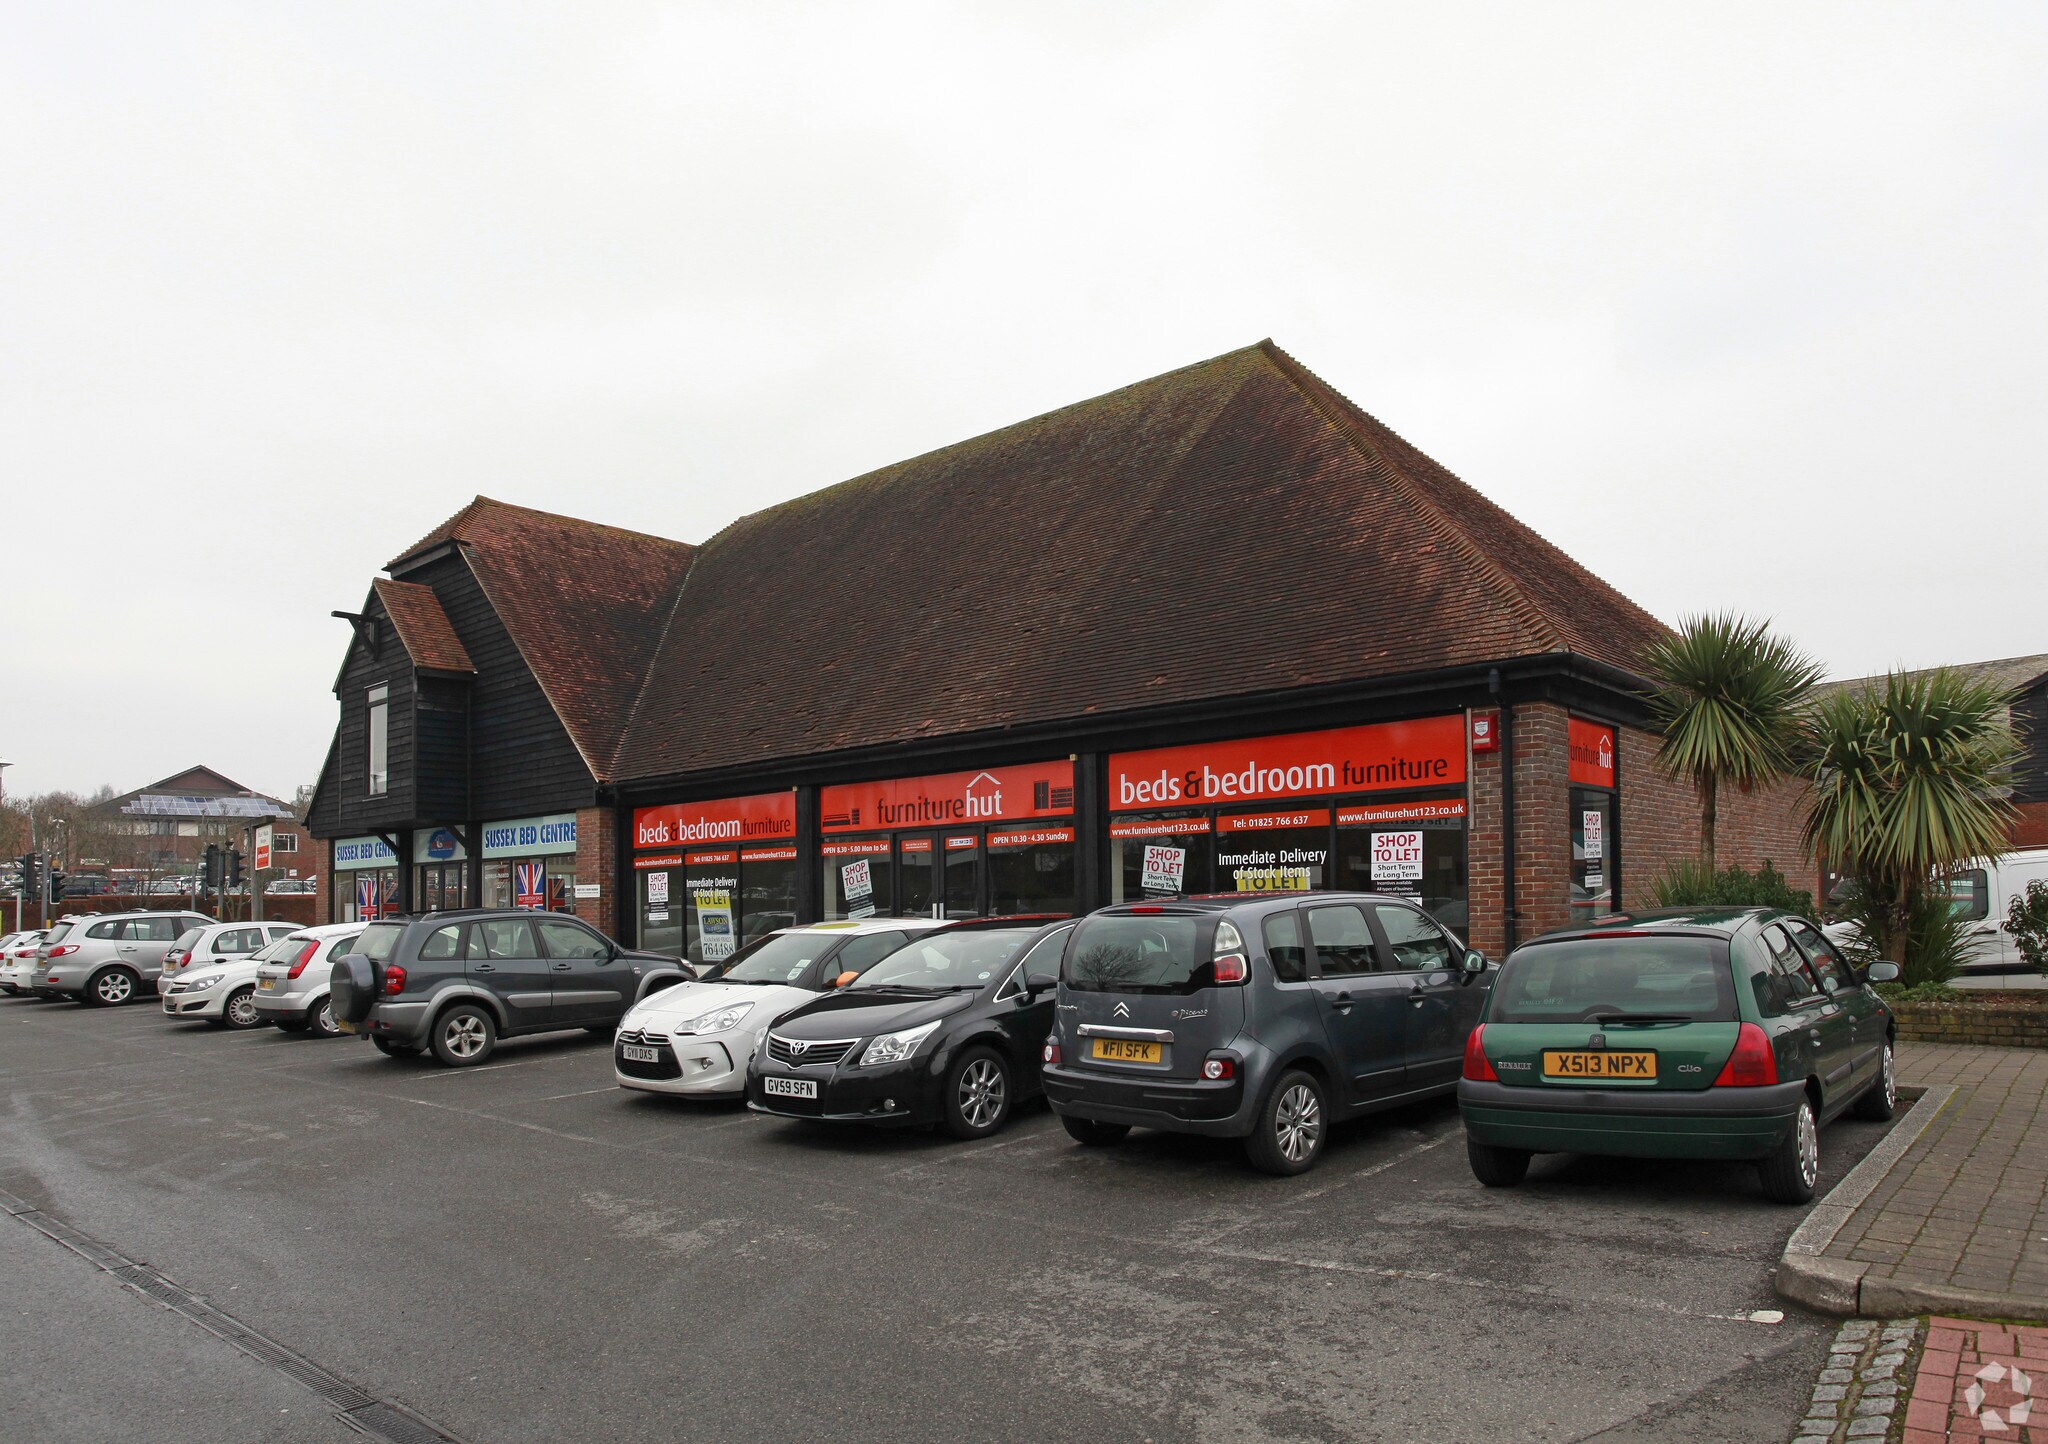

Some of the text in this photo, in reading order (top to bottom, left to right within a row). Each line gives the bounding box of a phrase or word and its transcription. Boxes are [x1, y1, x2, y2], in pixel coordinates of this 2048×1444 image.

[1569, 743, 1612, 768] urniturehut
[1120, 757, 1448, 804] beds & bedroom furniture
[877, 788, 1002, 825] furniturehut
[1339, 804, 1463, 822] www.furniturehut123.co.uk
[1233, 816, 1308, 828] Tel: 01825 766 637
[1586, 814, 1599, 825] SHOP
[485, 821, 576, 849] SUSSEX BED CENTRE
[639, 816, 791, 843] beds & bedroom furniture
[1112, 821, 1209, 836] www.furniturehut123.co.uk
[1585, 828, 1600, 839] TO LET
[993, 835, 1009, 844] OPEN
[1010, 834, 1027, 843] 10.30
[1031, 833, 1044, 842] 4.30
[1046, 831, 1069, 842] Sunday
[1377, 834, 1417, 848] SHOP
[337, 843, 359, 861] SUSSEX
[361, 843, 373, 860] BED
[1149, 848, 1180, 861] SHOP
[1218, 848, 1327, 865] Immediate Delivery
[1374, 849, 1420, 861] TO LET
[845, 862, 866, 876] SHOP
[1146, 860, 1182, 875] TO LET
[1233, 865, 1311, 880] of Stock Items
[650, 874, 665, 883] SHOP
[686, 877, 737, 889] Immediate Delivery
[845, 872, 869, 886] TO LET
[1242, 877, 1299, 890] TO LET
[693, 888, 730, 898] of Stock Items
[698, 896, 728, 904] TO LET
[704, 943, 734, 955] 764488
[627, 1047, 653, 1060] GY11 DXS
[1103, 1041, 1150, 1059] WF11 SFK
[1498, 1062, 1532, 1070] RENAULT
[1559, 1055, 1648, 1074] X513 NPX
[1678, 1064, 1701, 1073] Clio
[768, 1080, 813, 1096] GV59 SFN
